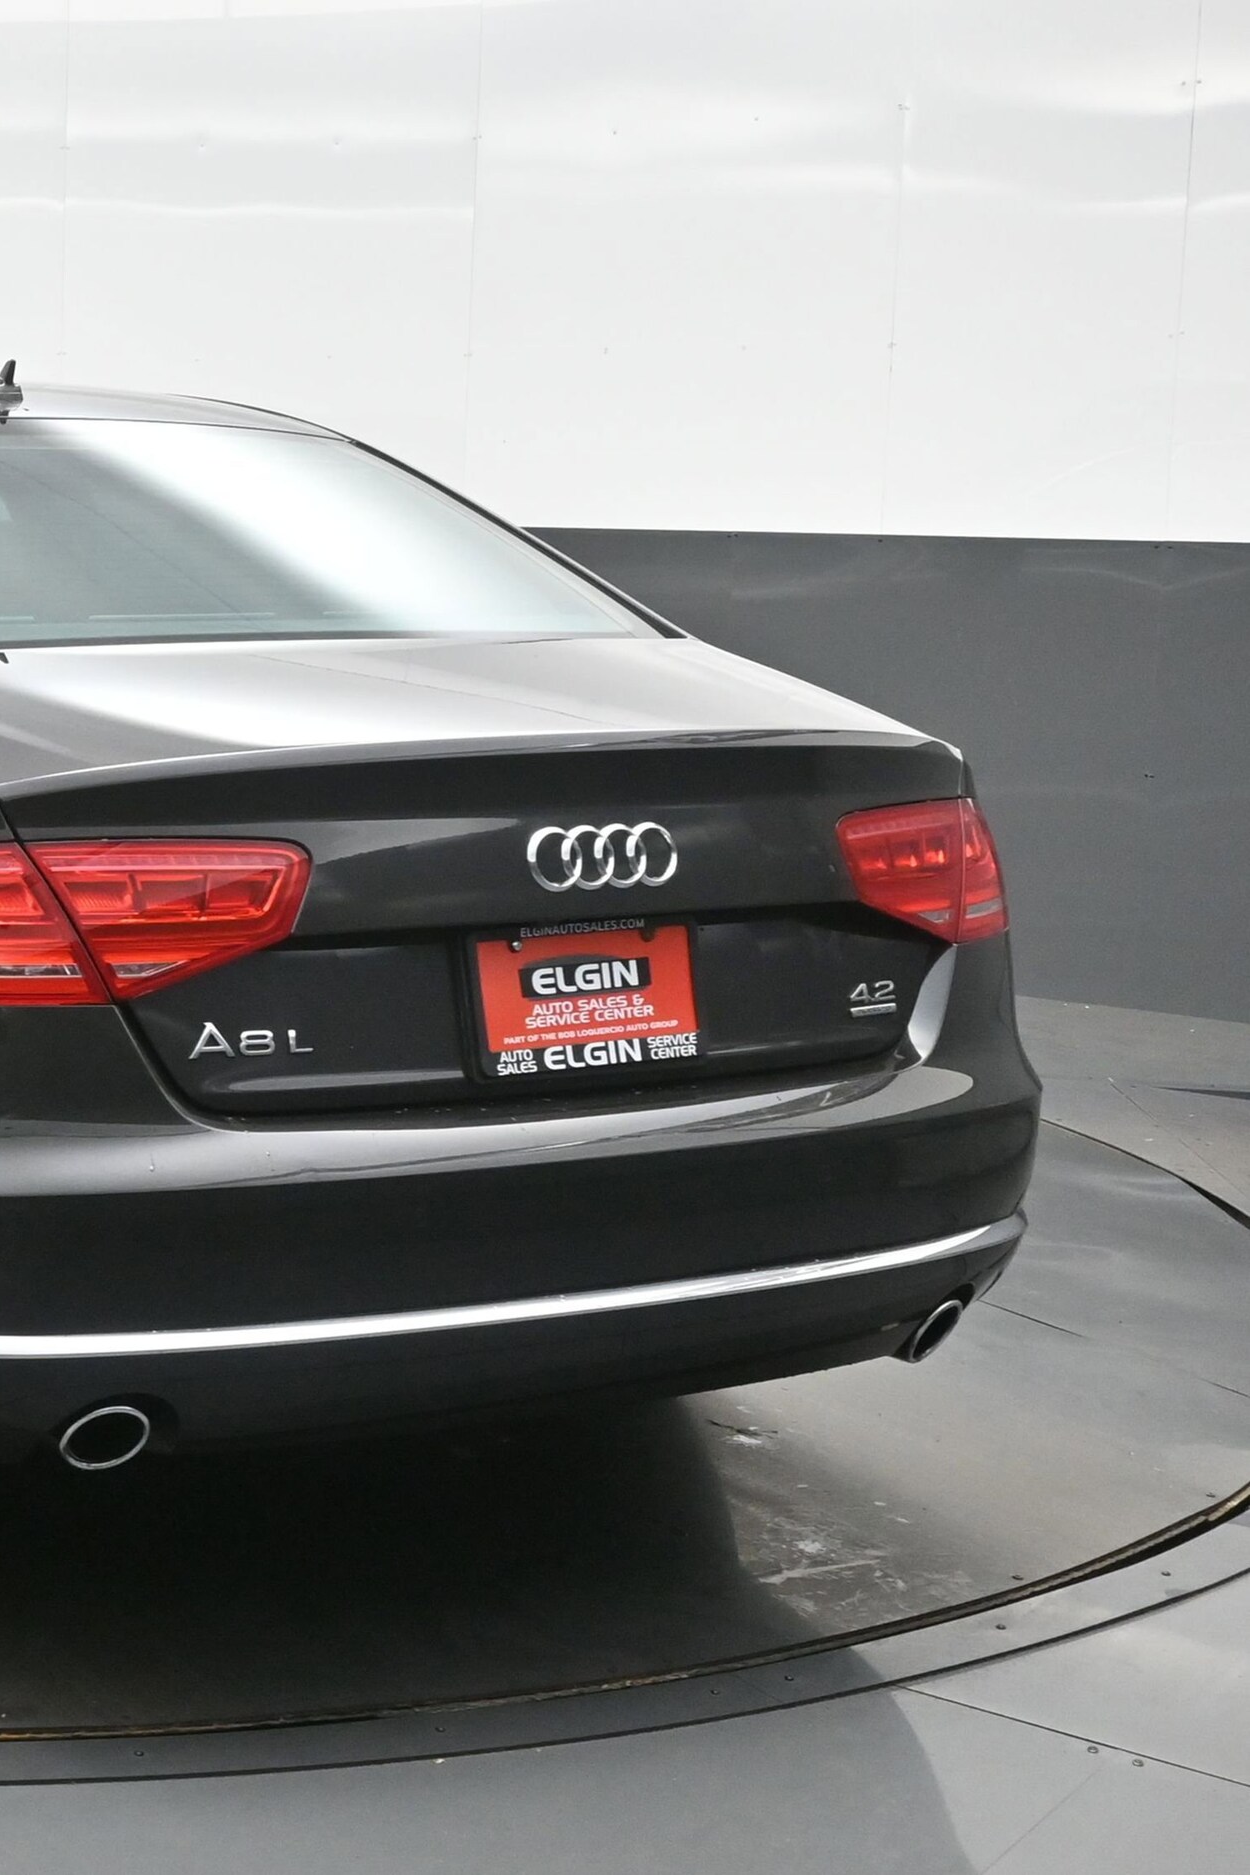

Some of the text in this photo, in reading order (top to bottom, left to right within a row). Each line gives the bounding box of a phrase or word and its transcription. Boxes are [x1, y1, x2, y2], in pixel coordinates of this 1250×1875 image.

[520, 919, 645, 938] ELGINAUTOSALES.COM
[532, 960, 640, 996] ELGIN
[532, 994, 644, 1015] AUTO SALES &
[525, 1005, 654, 1029] SERVICE CENTER
[504, 1035, 525, 1045] PART
[527, 1033, 539, 1043] OF
[540, 1032, 556, 1041] THE
[558, 1030, 575, 1040] BOB
[626, 1022, 648, 1033] AUTO
[650, 1020, 678, 1031] GROUP
[647, 1033, 697, 1049] SERVICE
[499, 1049, 533, 1063] AUTO
[543, 1039, 642, 1070] ELGIN
[651, 1046, 697, 1060] CENTER
[497, 1061, 537, 1076] SALES
